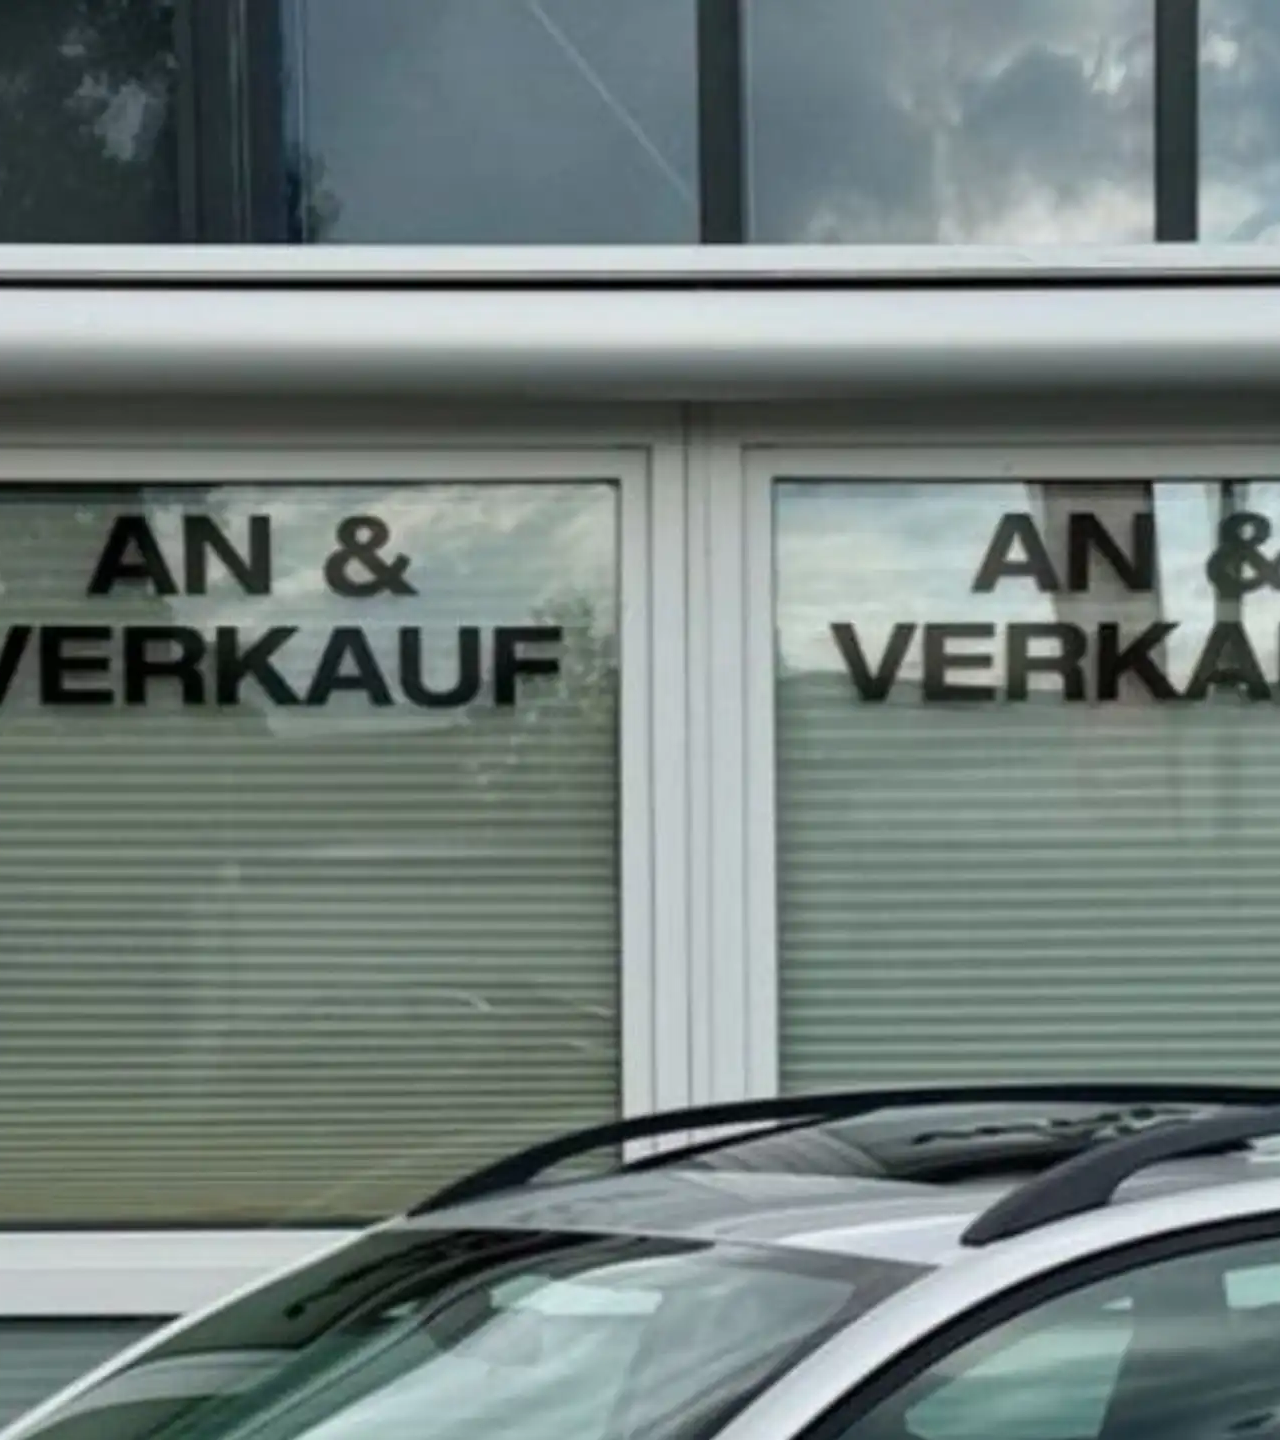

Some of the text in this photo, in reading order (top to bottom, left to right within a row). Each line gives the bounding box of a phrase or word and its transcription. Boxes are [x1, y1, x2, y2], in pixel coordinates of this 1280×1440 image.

[87, 514, 418, 599] AN &
[971, 511, 1153, 594] AN
